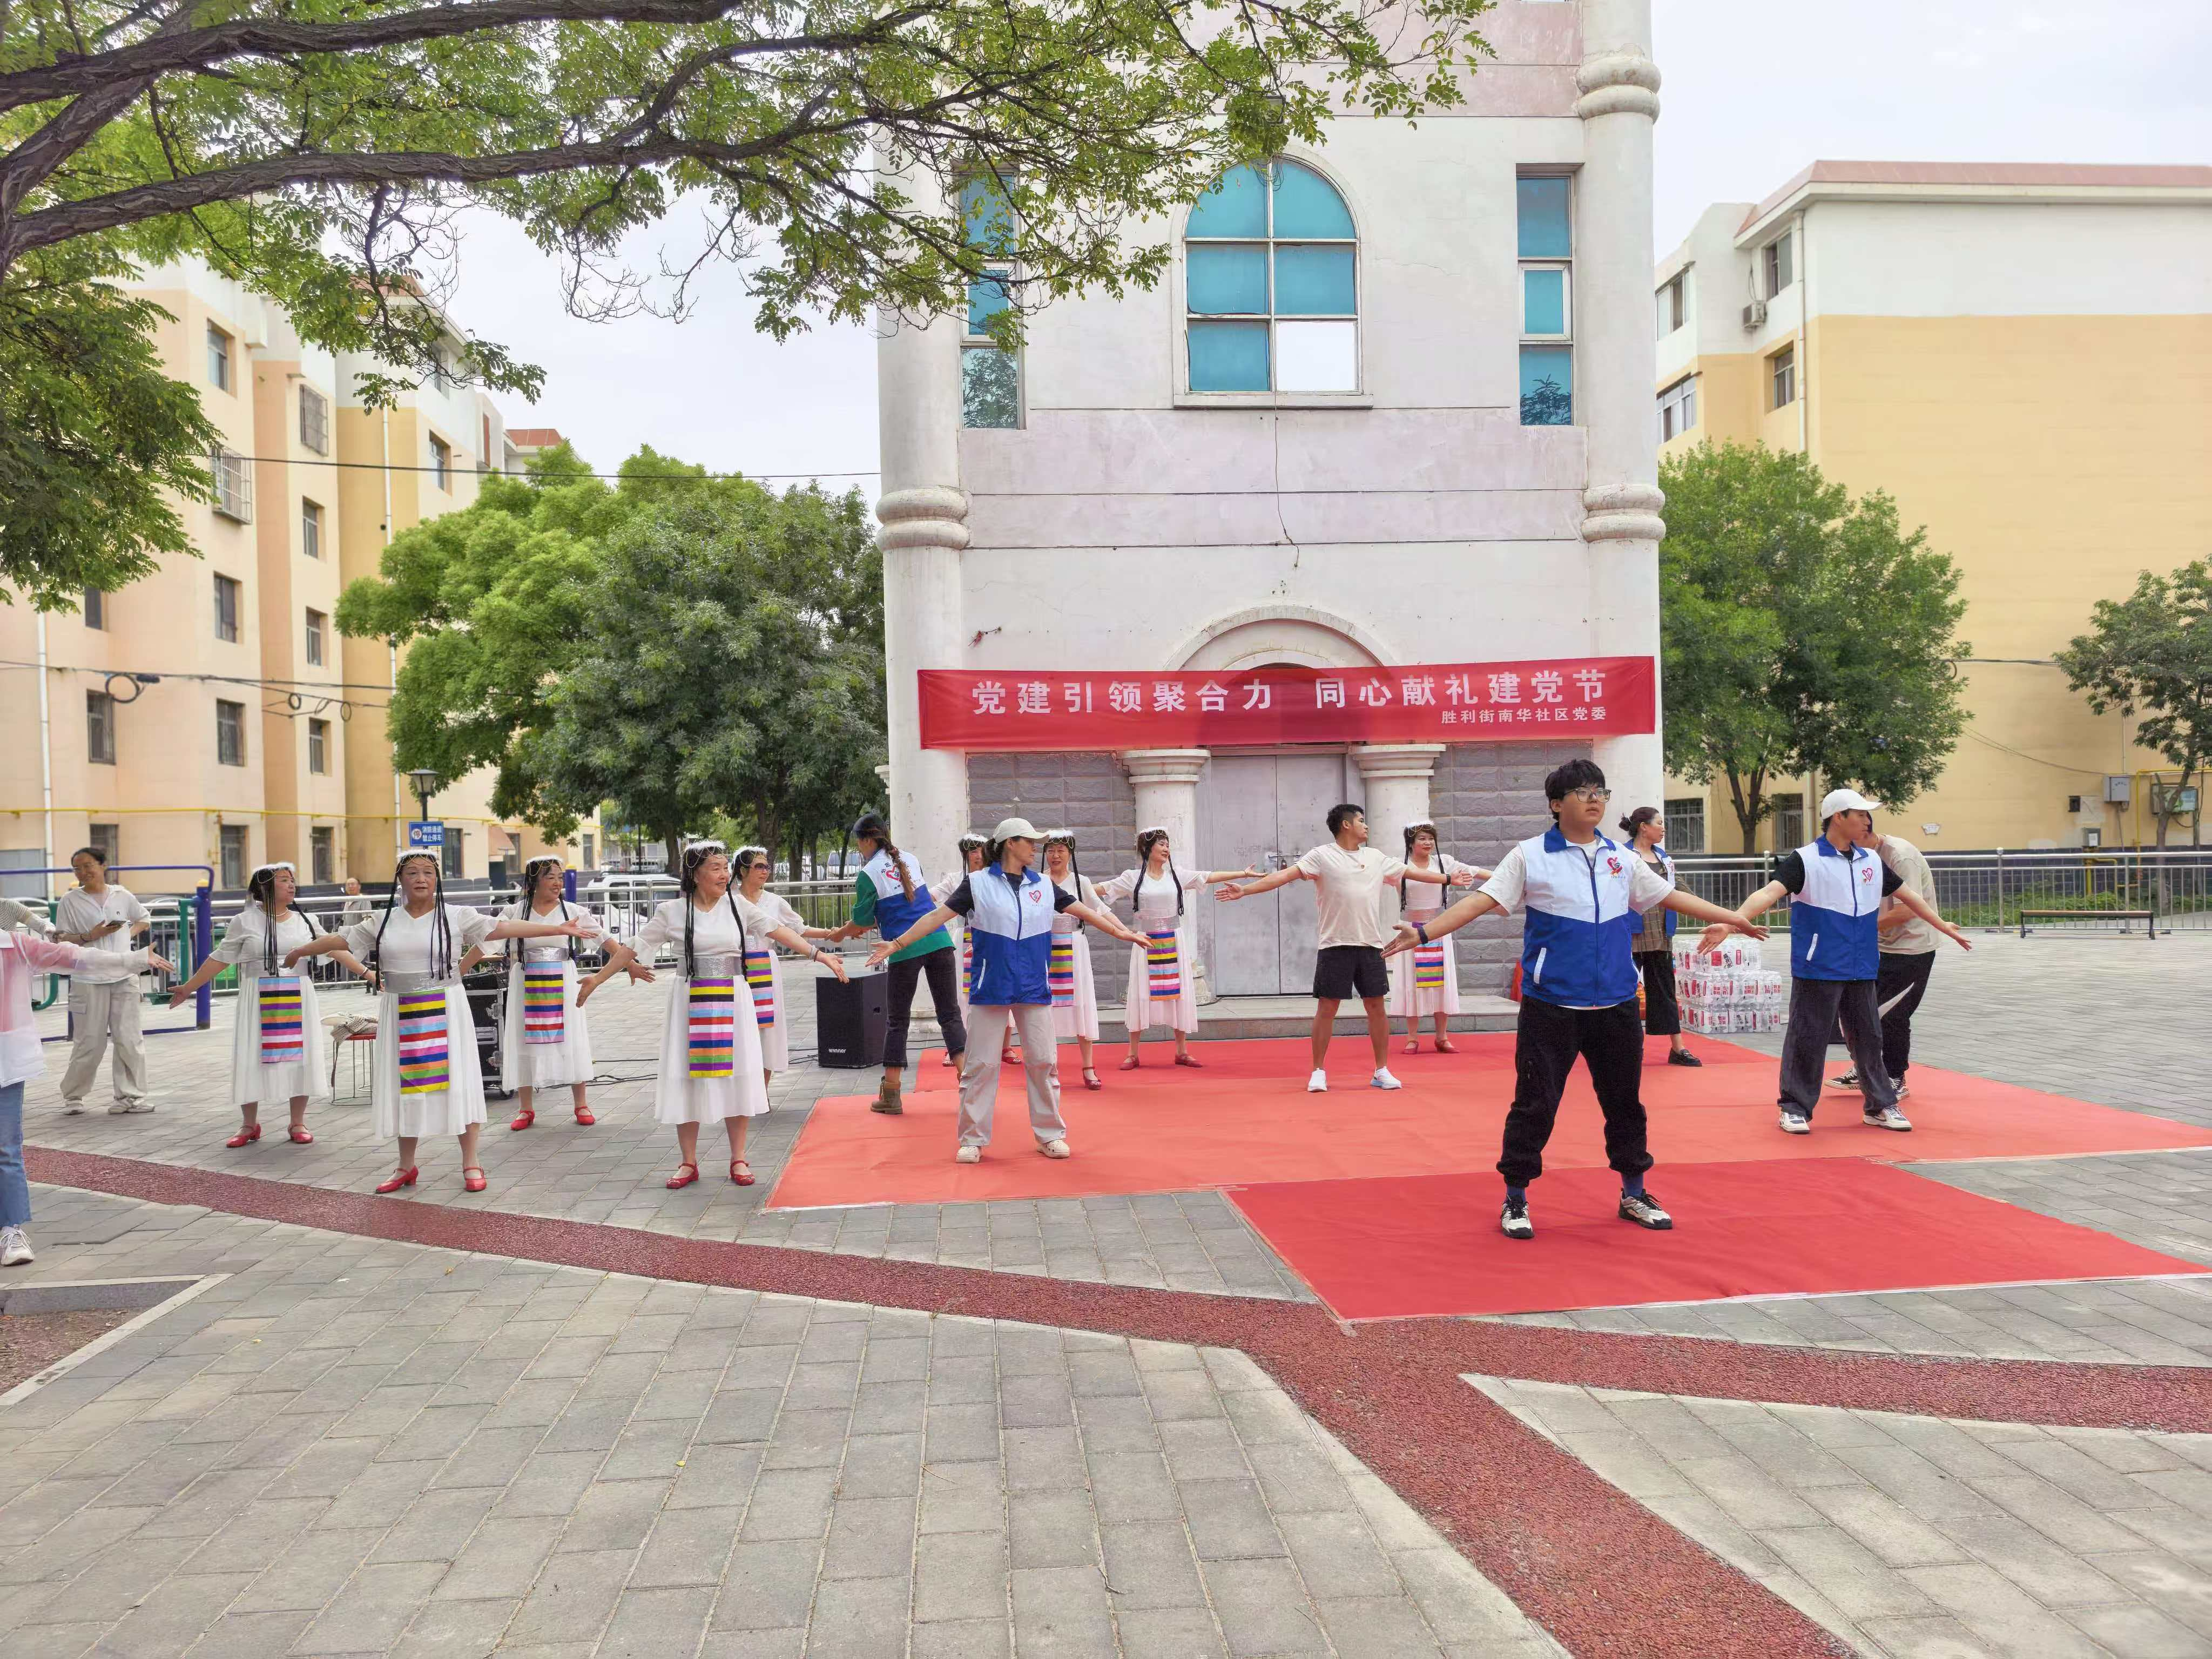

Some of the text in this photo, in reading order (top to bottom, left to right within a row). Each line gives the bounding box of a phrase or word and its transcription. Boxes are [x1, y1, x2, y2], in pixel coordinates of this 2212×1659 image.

[972, 669, 1606, 714] 党建引领聚合力 同心献礼建党节
[1441, 706, 1607, 724] 胜利街南华社区党委
[423, 834, 442, 842] 禁止停车
